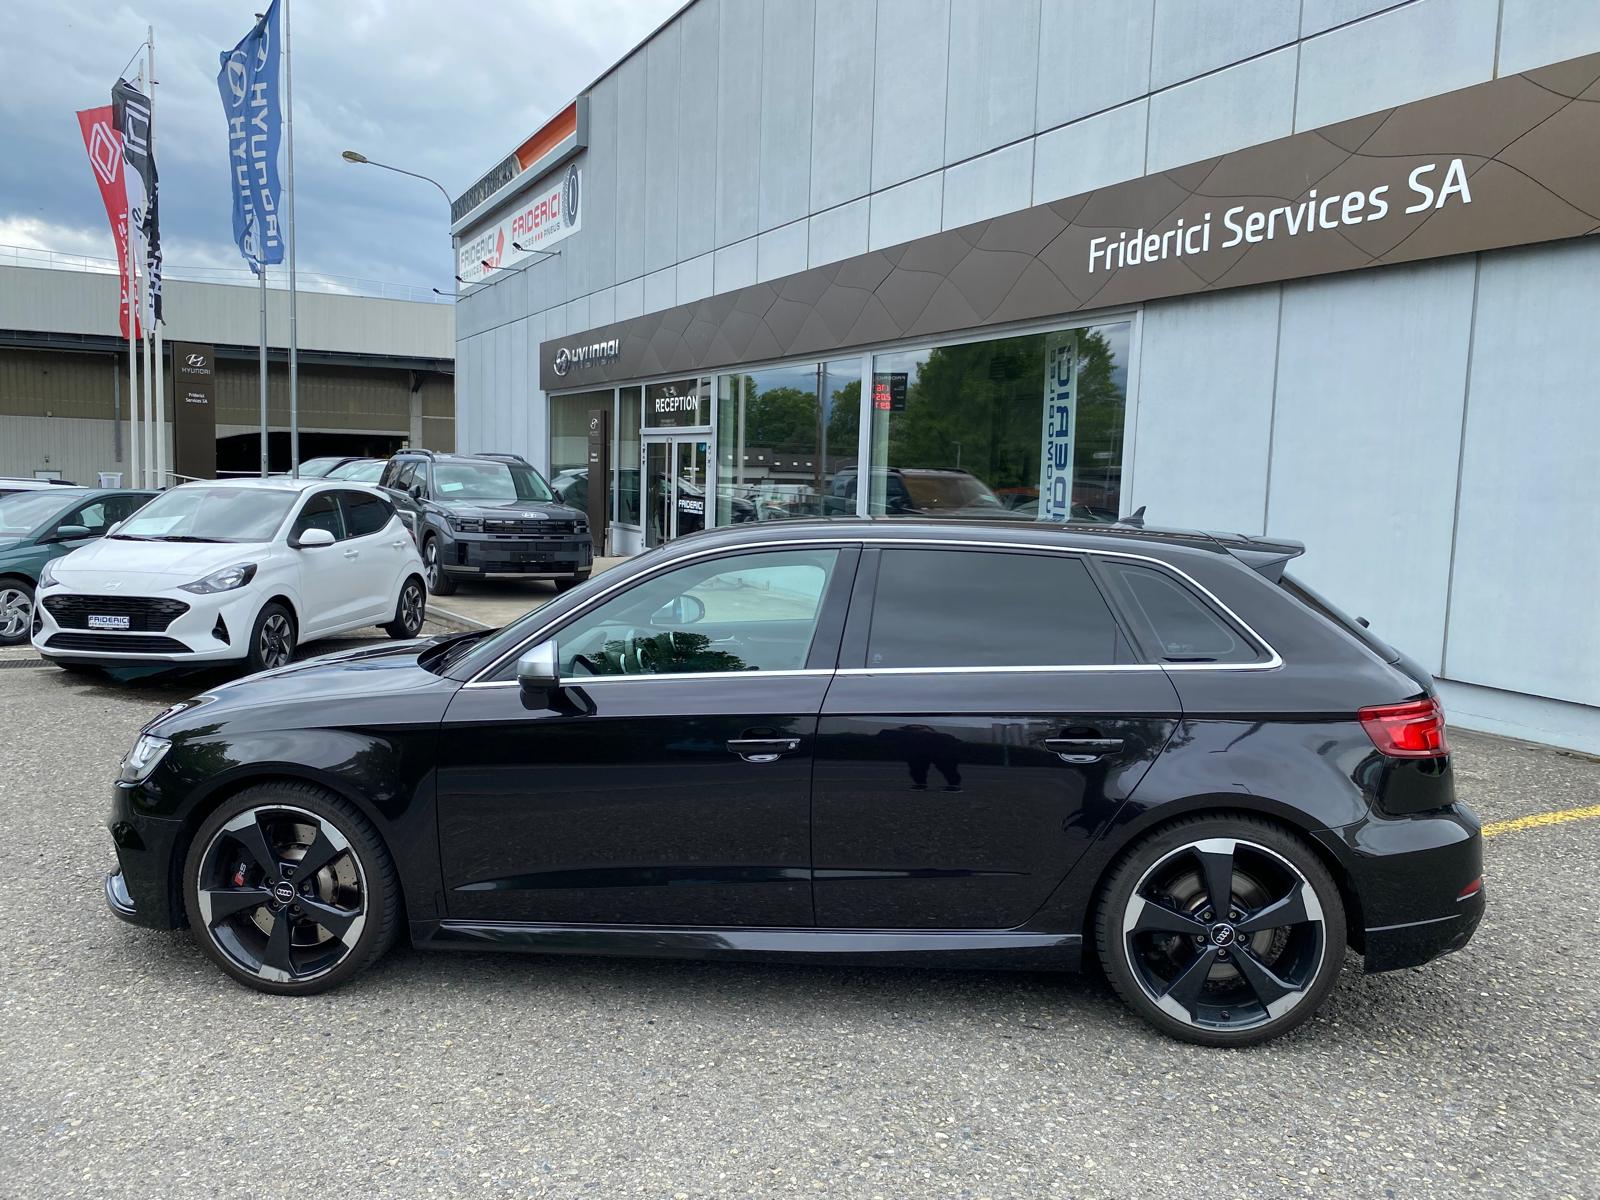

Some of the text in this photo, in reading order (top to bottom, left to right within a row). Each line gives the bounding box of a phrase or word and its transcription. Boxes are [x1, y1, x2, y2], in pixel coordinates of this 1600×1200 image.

[250, 82, 278, 247] HYUNDAI
[512, 192, 561, 241] FRIDERICI
[1088, 158, 1472, 273] Friderici Services SA
[181, 367, 211, 375] HYUNDAI
[655, 395, 698, 413] RECEPTION
